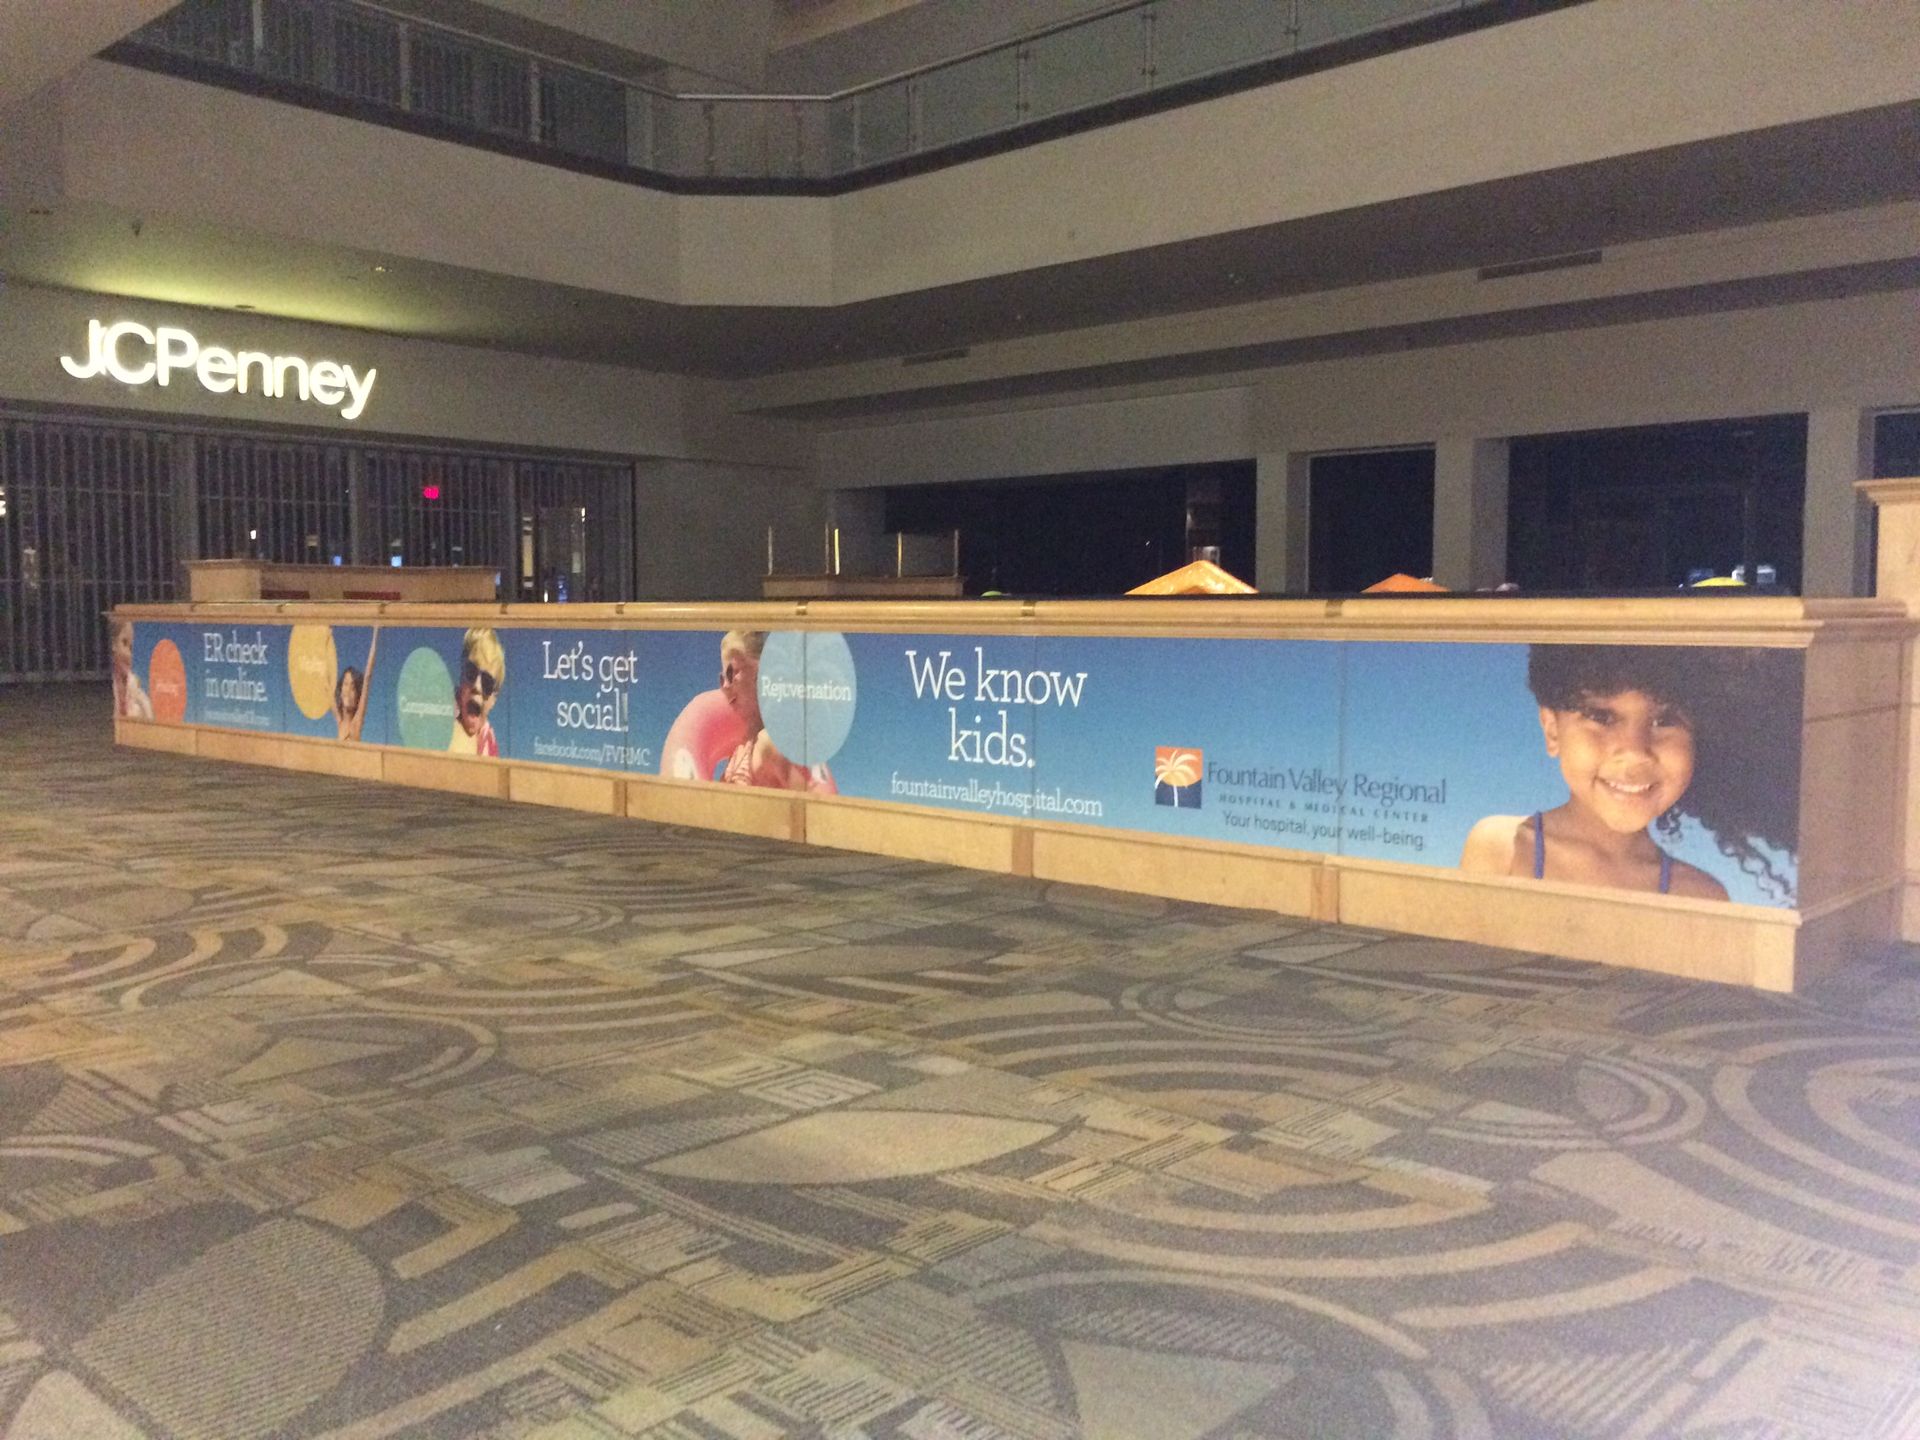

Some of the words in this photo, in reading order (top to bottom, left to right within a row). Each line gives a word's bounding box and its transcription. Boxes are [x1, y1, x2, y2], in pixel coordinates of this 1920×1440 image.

[60, 319, 376, 420] JCPenney
[203, 632, 225, 662] ER
[226, 630, 268, 665] check
[205, 669, 218, 698] in
[221, 667, 268, 701] online.
[599, 650, 639, 693] get
[761, 676, 851, 702] Rejuvenation
[905, 650, 967, 700] We
[974, 647, 1088, 708] know
[557, 688, 629, 732] social!
[948, 707, 1036, 769] kids.
[891, 771, 1104, 817] fountainvalleyhospital.com
[1207, 761, 1285, 790] Fountain
[1287, 767, 1348, 800] Valley
[1354, 773, 1447, 807] Regional
[1219, 793, 1281, 809] HOSPITAL
[1304, 803, 1365, 817] MEDICAL
[1373, 808, 1429, 823] CENTER
[1222, 810, 1251, 828] Your
[1312, 827, 1343, 841] your
